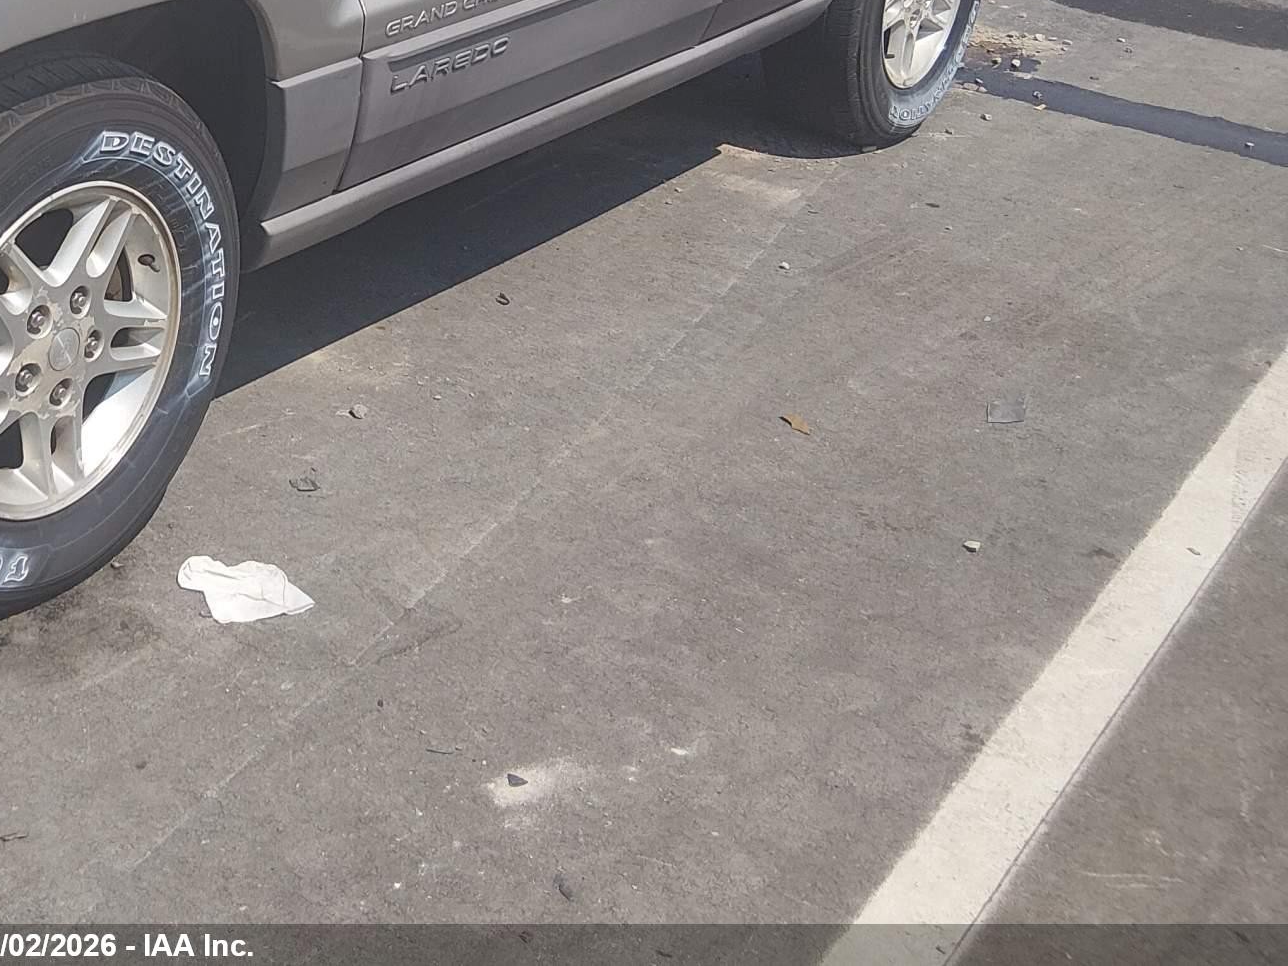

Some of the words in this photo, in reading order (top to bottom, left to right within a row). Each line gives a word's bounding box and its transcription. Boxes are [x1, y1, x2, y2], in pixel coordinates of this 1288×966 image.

[385, 1, 458, 37] GRAND
[390, 36, 511, 94] LAREDO
[98, 130, 227, 377] DESTINATION
